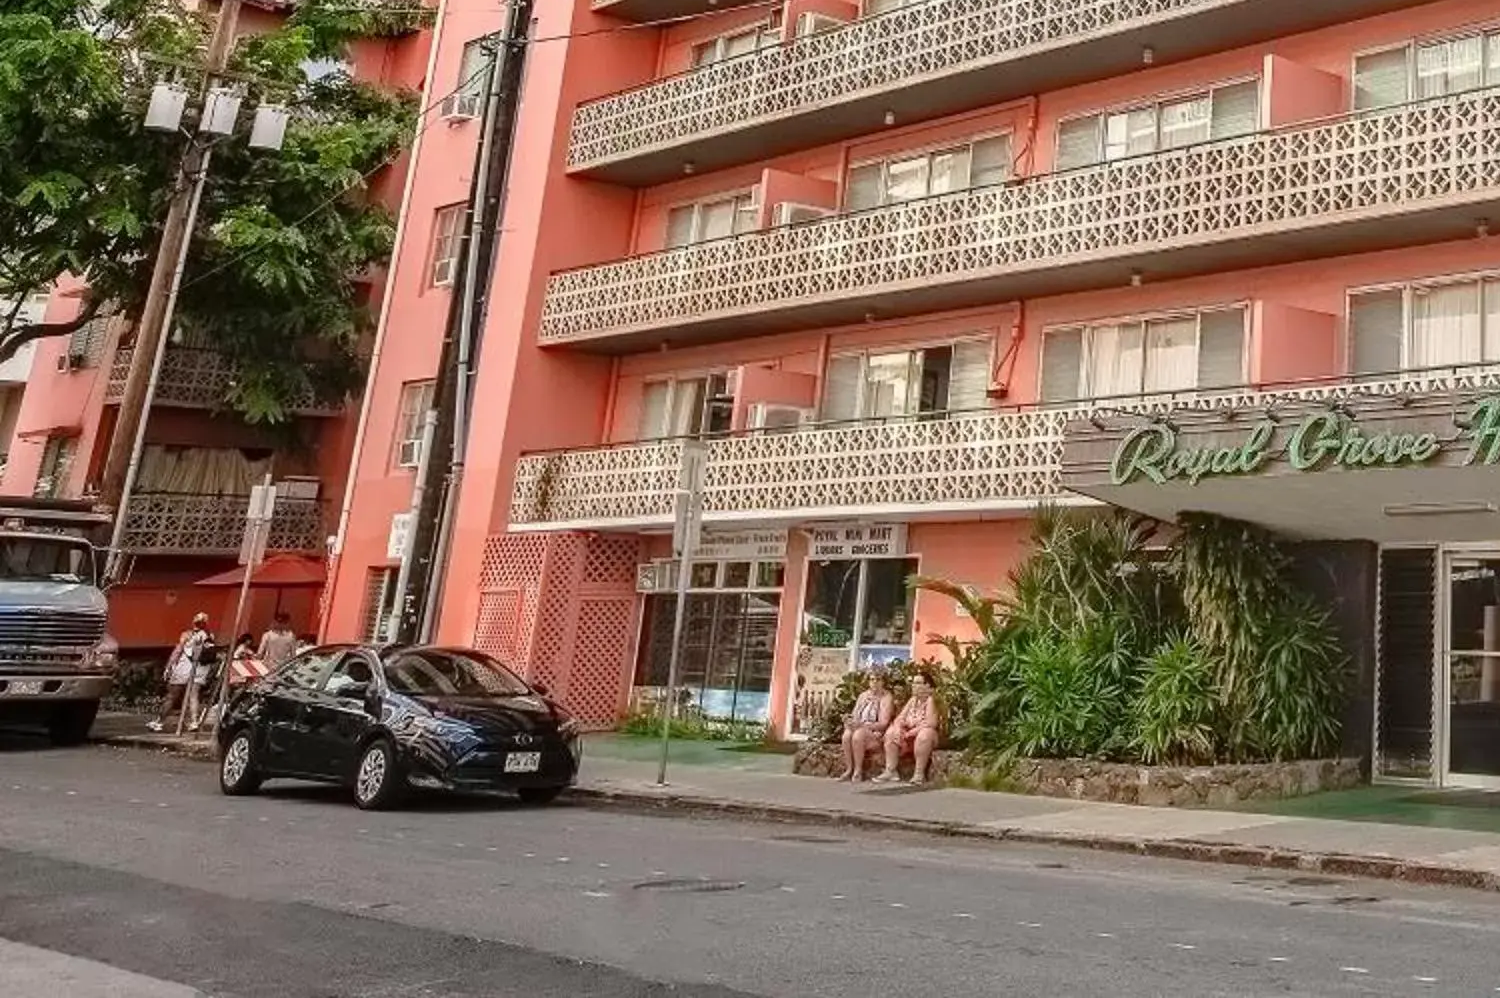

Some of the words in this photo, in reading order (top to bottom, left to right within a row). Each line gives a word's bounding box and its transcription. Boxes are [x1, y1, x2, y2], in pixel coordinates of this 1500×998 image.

[1110, 418, 1277, 486] Royal
[1289, 410, 1441, 470] Grove
[869, 527, 893, 540] MART
